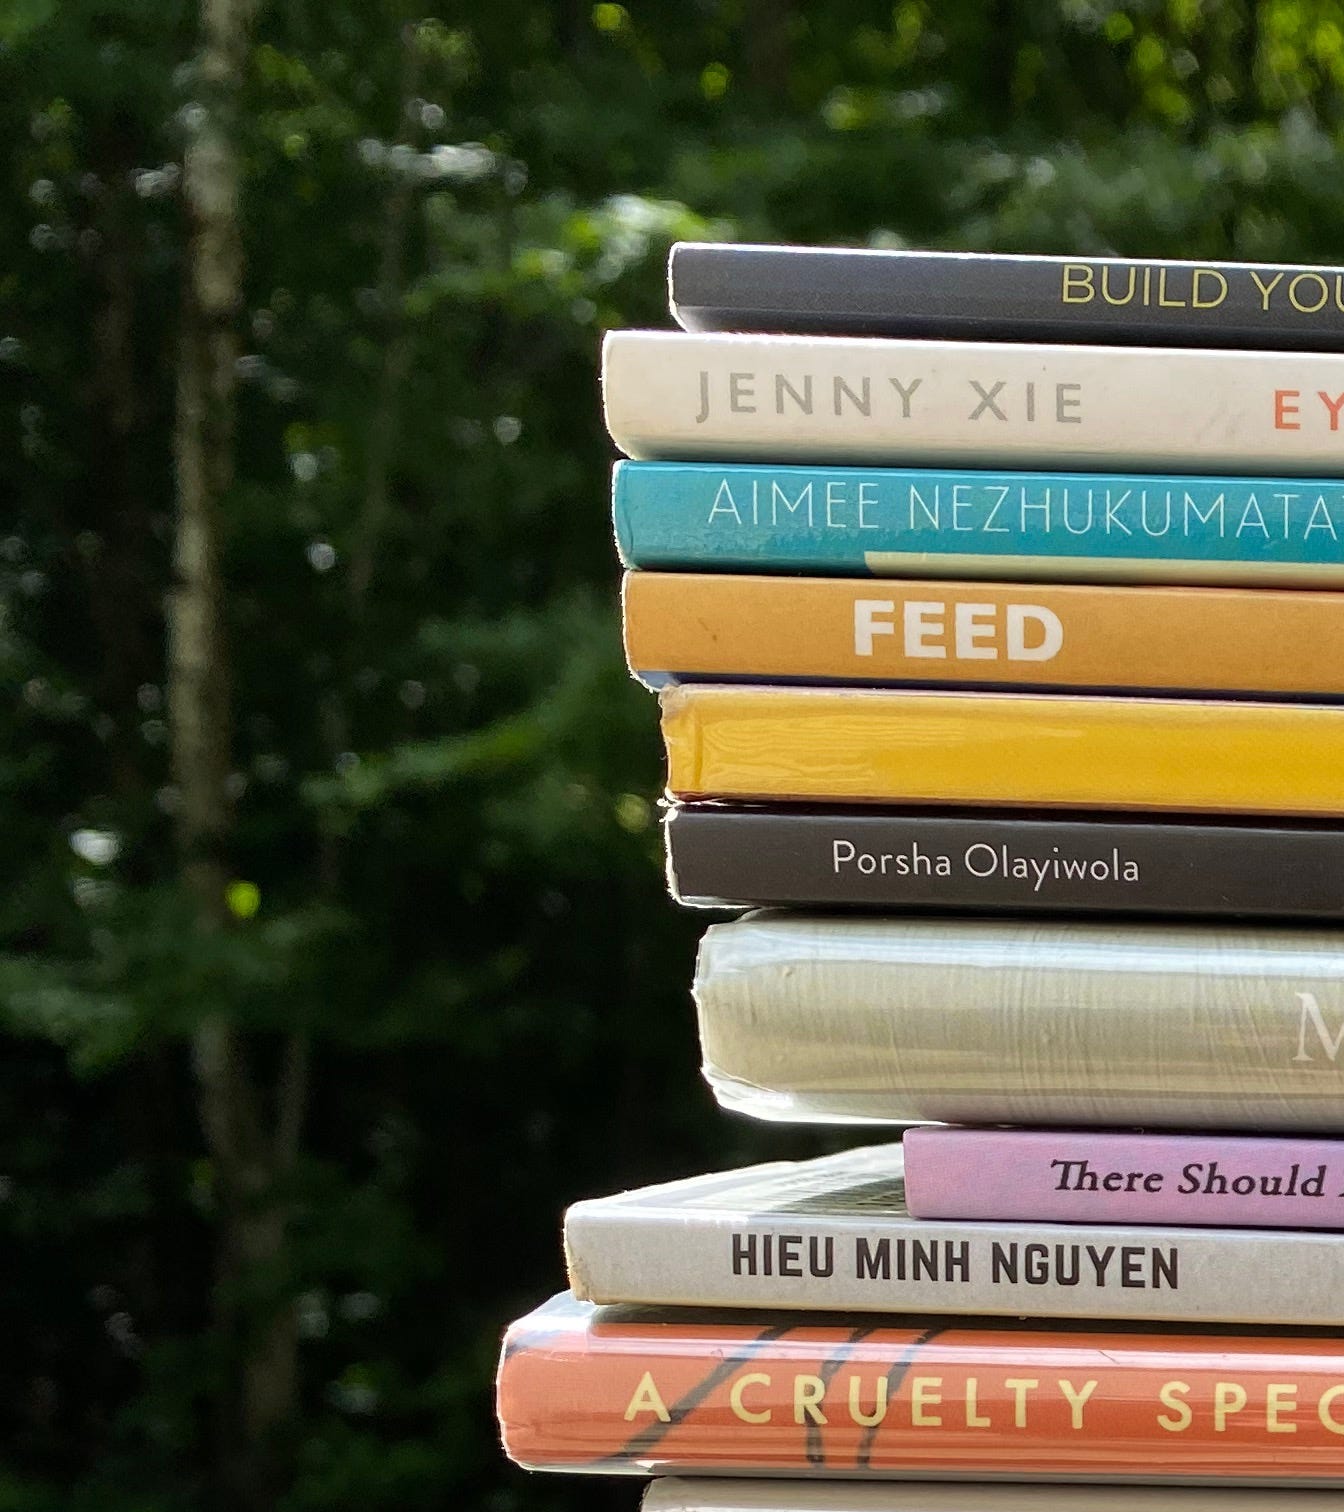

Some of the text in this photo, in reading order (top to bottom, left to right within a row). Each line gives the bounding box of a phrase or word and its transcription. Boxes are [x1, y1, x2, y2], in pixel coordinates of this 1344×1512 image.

[1061, 265, 1228, 309] BUILD
[696, 370, 1082, 424] JENNY XIE
[708, 479, 880, 531] AIMEE
[853, 601, 1064, 662] FEED
[834, 841, 1140, 891] Porsha Olayiwola
[1050, 1159, 1163, 1195] There
[1178, 1163, 1325, 1198] Should
[732, 1233, 1179, 1291] HIEU MINH NGUYEN
[624, 1371, 673, 1424] A
[730, 1371, 1101, 1431] CRUELTY
